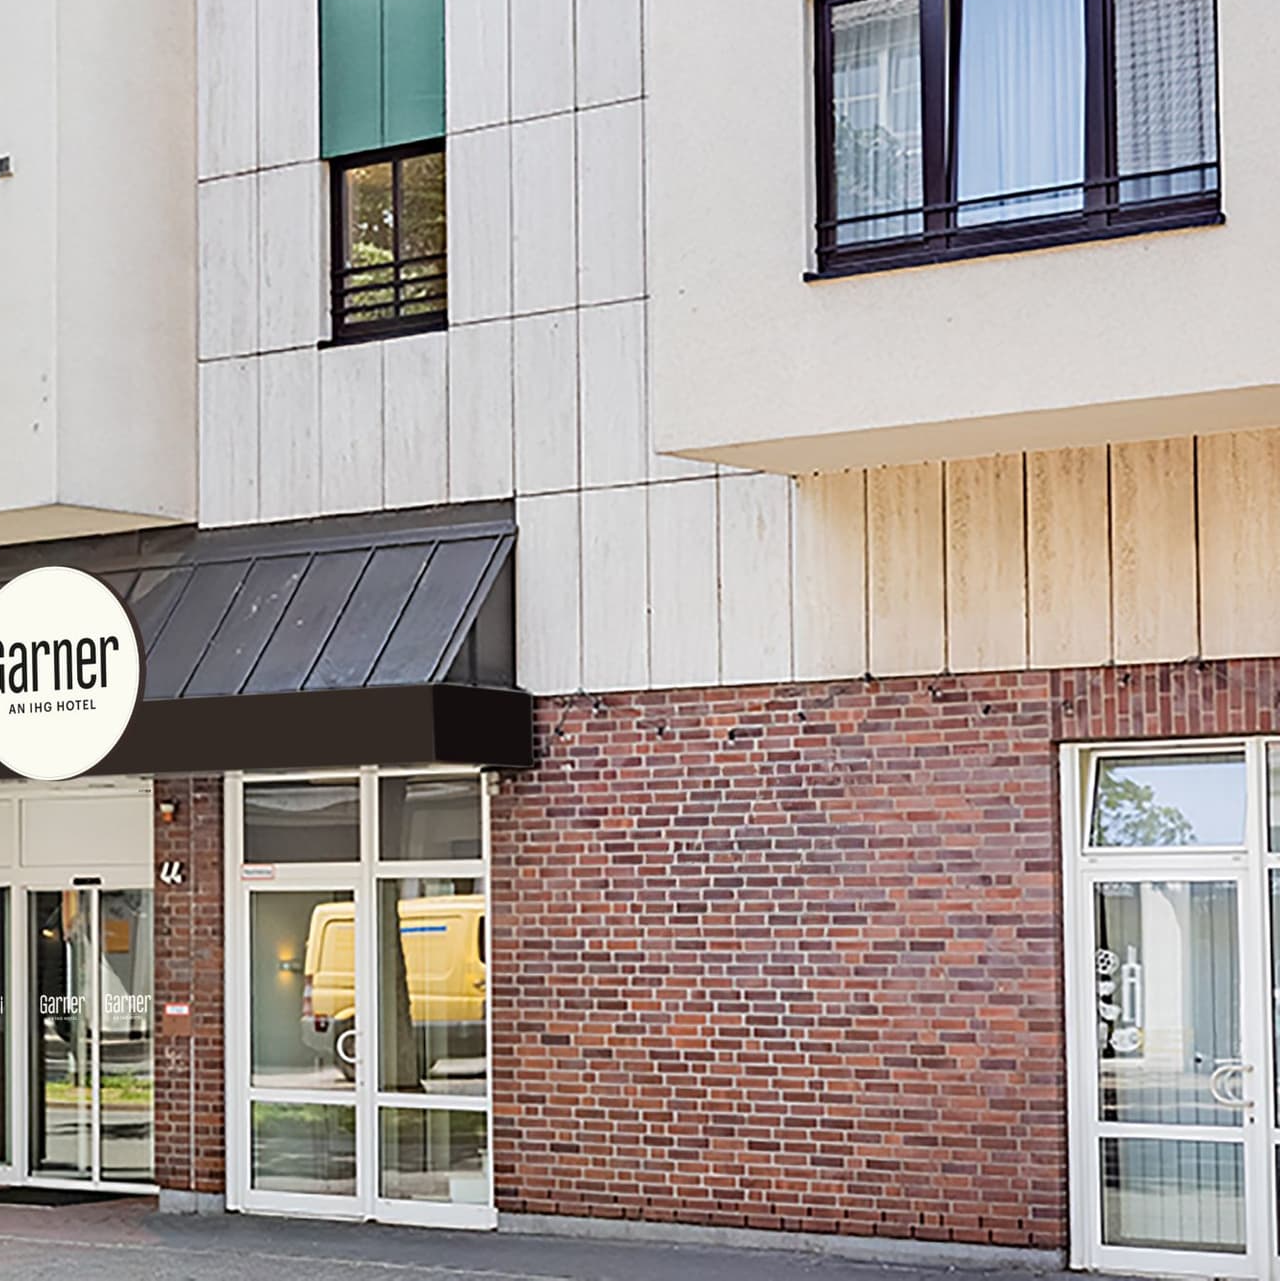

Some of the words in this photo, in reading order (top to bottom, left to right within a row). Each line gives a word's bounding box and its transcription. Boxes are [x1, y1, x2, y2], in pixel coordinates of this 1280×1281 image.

[8, 703, 26, 715] AN
[29, 701, 53, 713] IHG
[56, 699, 97, 712] HOTEL
[39, 994, 87, 1015] Garner
[103, 992, 152, 1014] Garner
